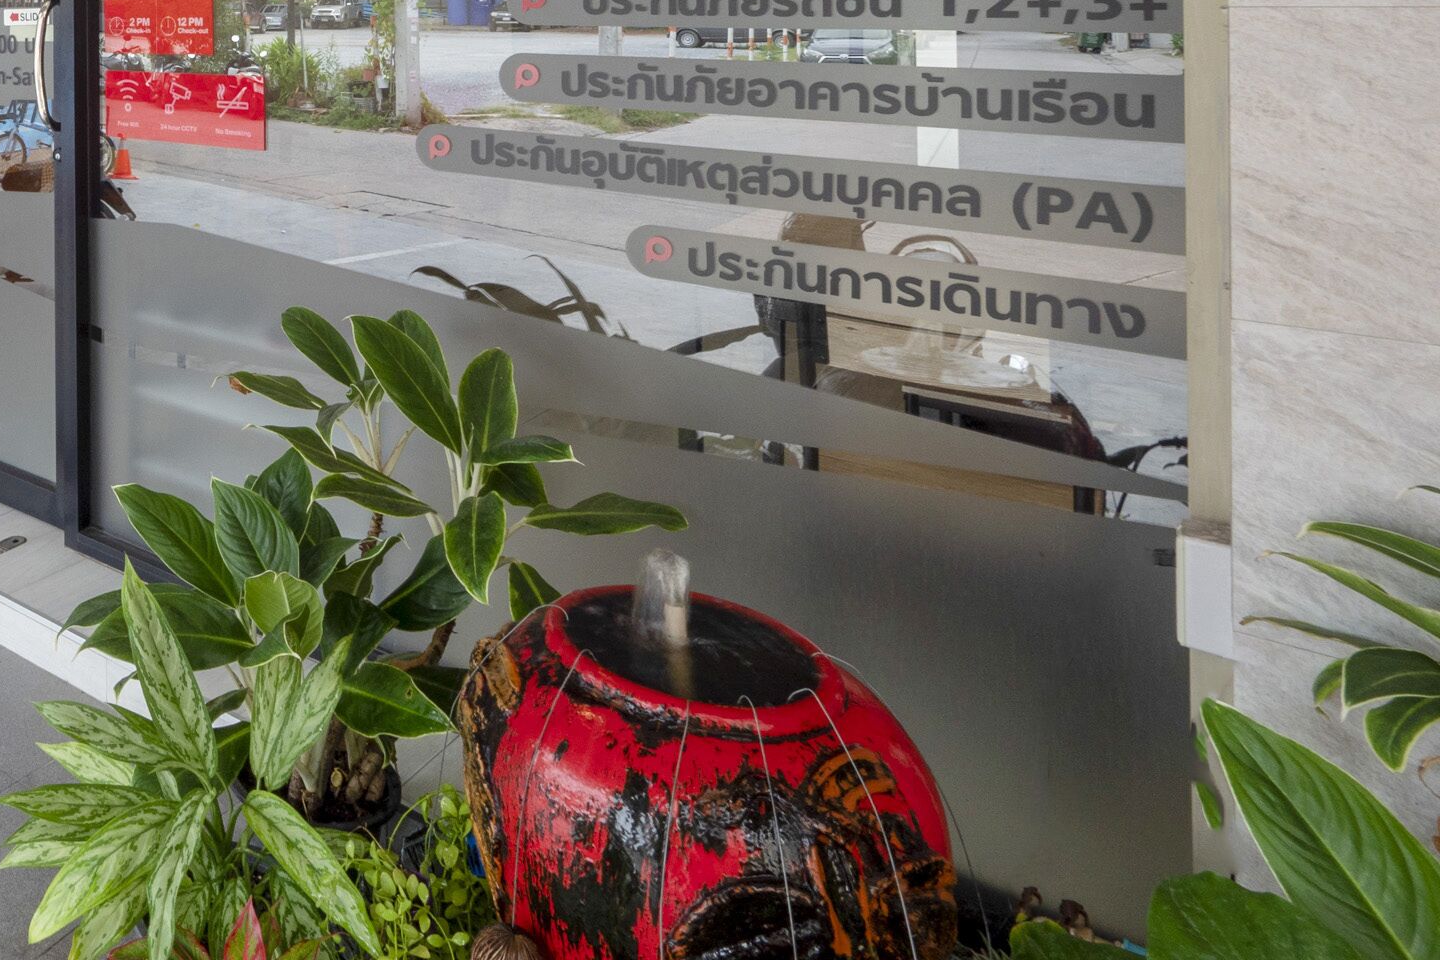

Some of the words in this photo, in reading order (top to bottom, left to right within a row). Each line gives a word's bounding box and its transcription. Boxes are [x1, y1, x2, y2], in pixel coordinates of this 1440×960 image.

[19, 12, 41, 21] SLID
[136, 18, 151, 27] PM
[177, 17, 187, 27] 12
[188, 17, 204, 27] PM
[125, 27, 152, 35] Check-in
[177, 27, 209, 35] Check-out
[561, 62, 1156, 130] ประกันภัยอาคารบ้านเรือน
[470, 132, 982, 222] ประกันอุบัติเหตุส่วนบุคคล
[1010, 179, 1155, 244] (PA)
[687, 240, 1147, 340] ประกันการเดินทาง
